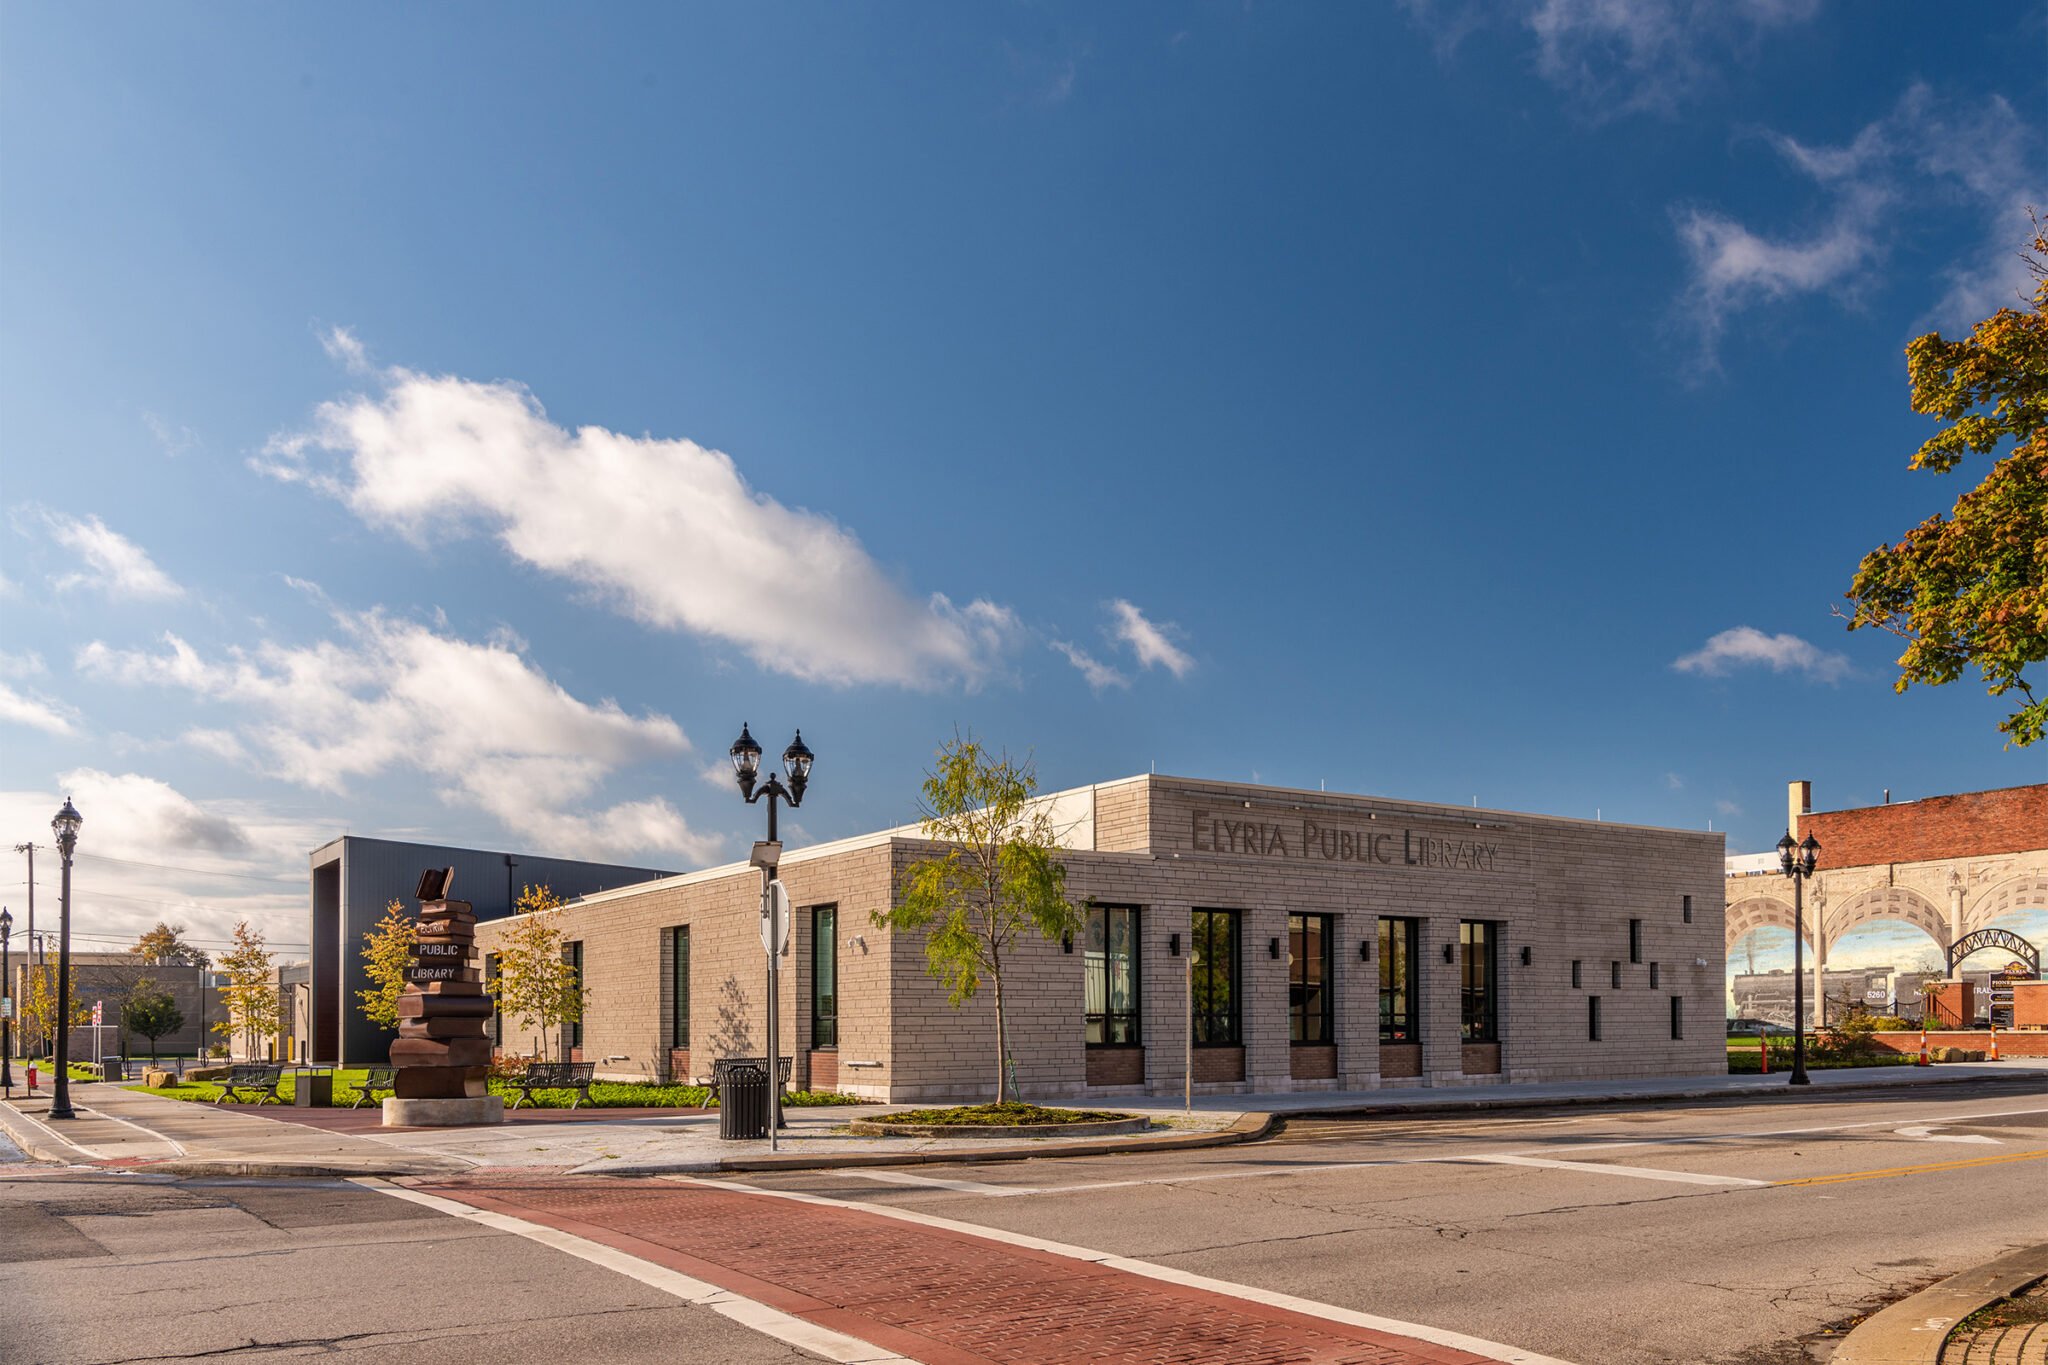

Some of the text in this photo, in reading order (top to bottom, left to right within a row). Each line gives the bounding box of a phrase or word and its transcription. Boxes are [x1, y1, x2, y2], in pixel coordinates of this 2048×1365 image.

[1193, 810, 1498, 870] ELYRIA PUBLIC LIBRARY
[420, 945, 458, 955] PUBLIC
[411, 968, 455, 979] LIBRARY
[1867, 990, 1886, 998] 5260
